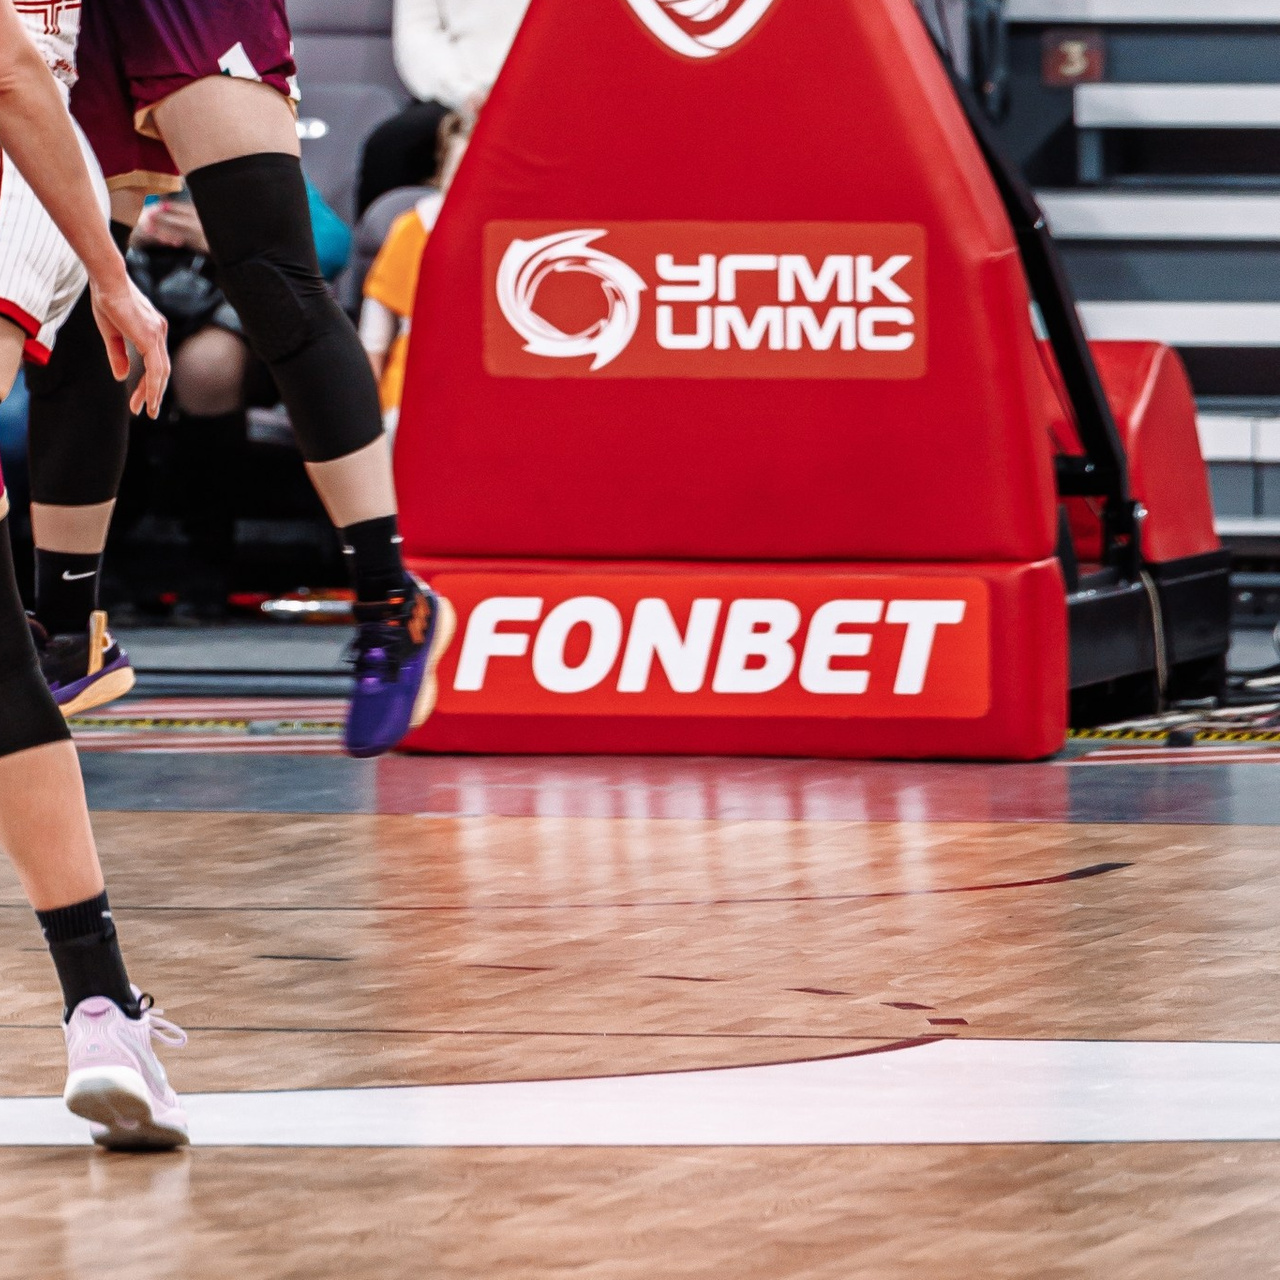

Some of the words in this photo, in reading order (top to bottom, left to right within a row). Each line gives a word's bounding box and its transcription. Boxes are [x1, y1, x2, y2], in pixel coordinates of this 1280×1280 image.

[654, 252, 914, 304] УГМК
[654, 306, 916, 352] UMMC
[453, 596, 966, 696] FONBET
